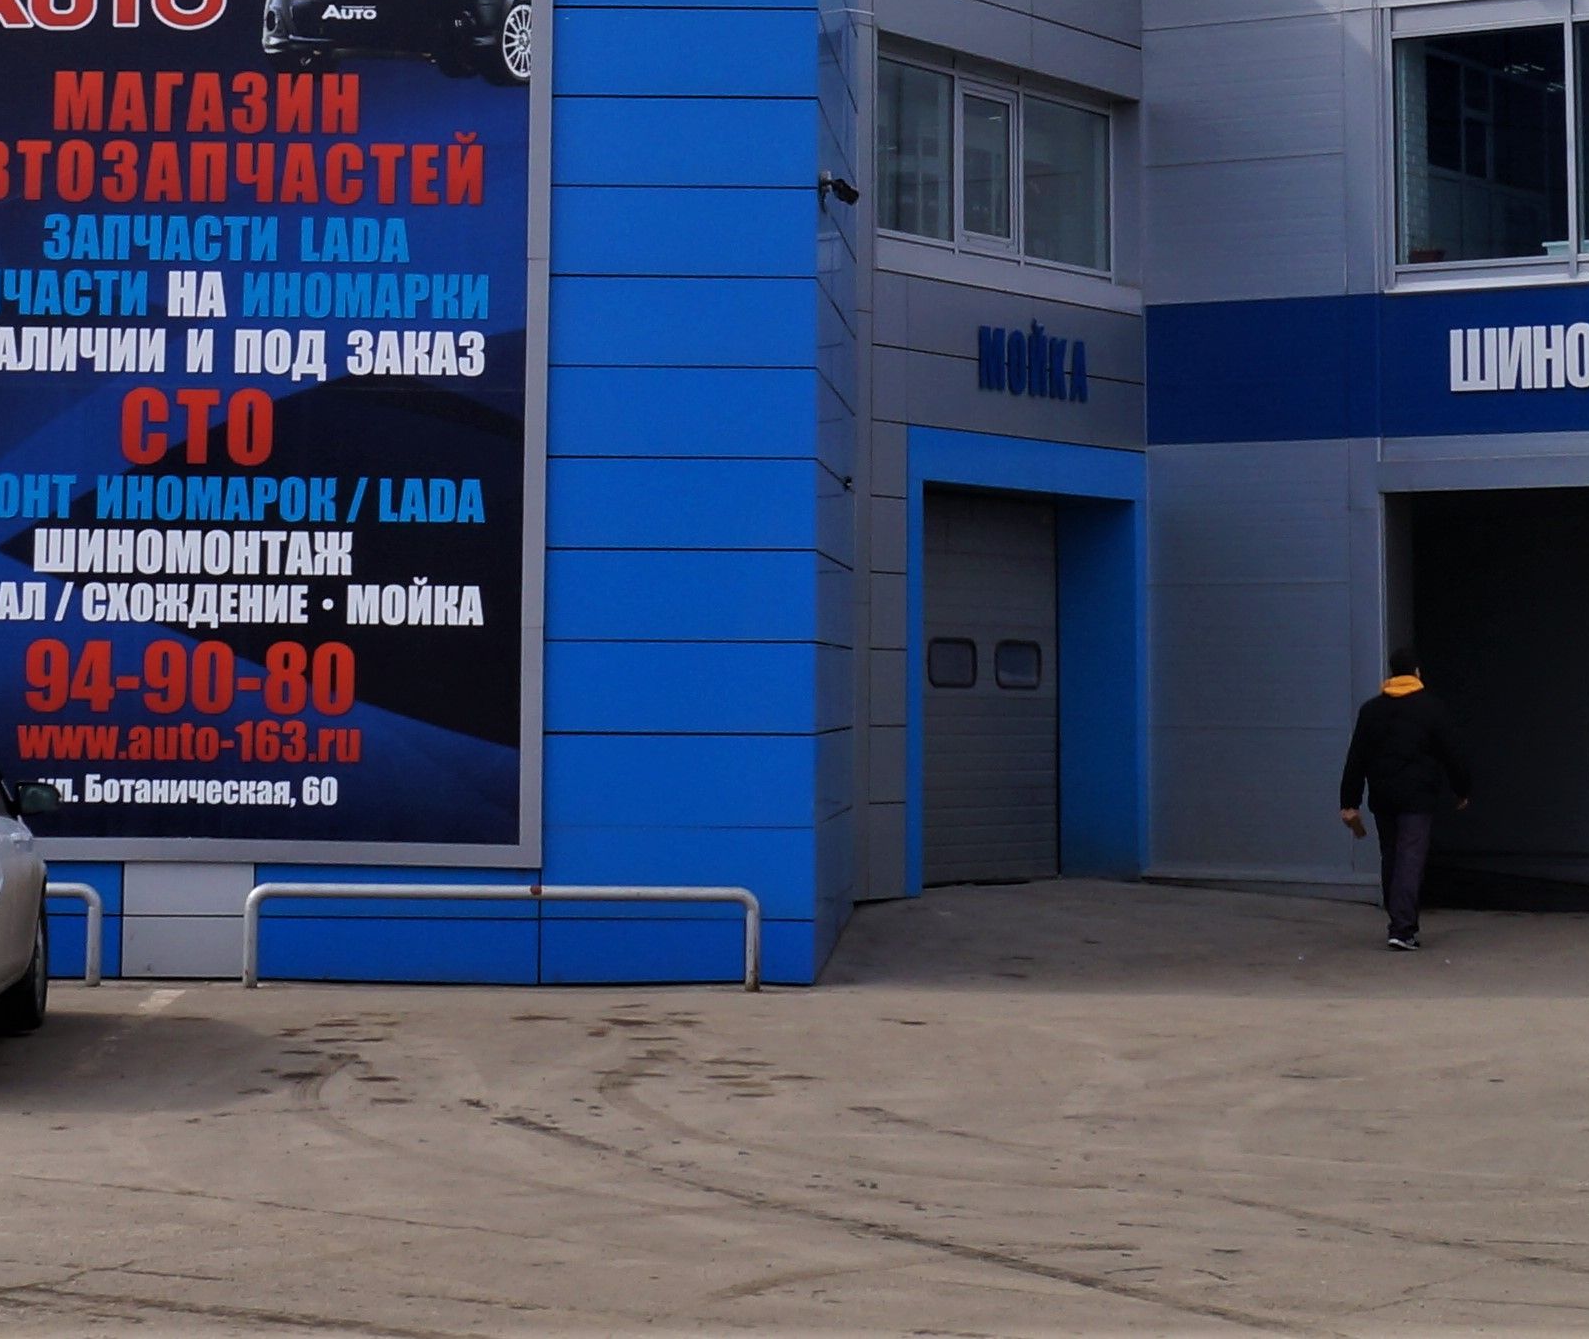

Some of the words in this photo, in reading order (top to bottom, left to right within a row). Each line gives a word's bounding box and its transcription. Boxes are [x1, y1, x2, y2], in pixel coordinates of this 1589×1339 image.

[52, 70, 361, 135] МАГАЗИН
[42, 212, 279, 263] ЗАПЧАСТИ
[301, 217, 410, 263] LADA
[166, 270, 227, 317] НА
[242, 272, 490, 320] ИНОМАРКИ
[187, 327, 214, 373] И
[233, 328, 328, 381] ПОД
[346, 330, 486, 377] ЗАКАЗ
[978, 318, 1089, 404] МОЙКА
[121, 386, 275, 467] СТО
[96, 474, 340, 523] ИНОМАРОК
[379, 478, 486, 524] LADA
[33, 528, 353, 576] ШИНОМОНТАЖ
[81, 583, 309, 629] СХОЖДЕНИЕ
[346, 576, 485, 627] МОЙКА
[25, 637, 356, 716] 94-90-80
[17, 720, 361, 763] www.auto-163.ru
[37, 777, 79, 803] л.
[84, 773, 297, 808] Ботаническая,
[301, 775, 339, 807] 60
